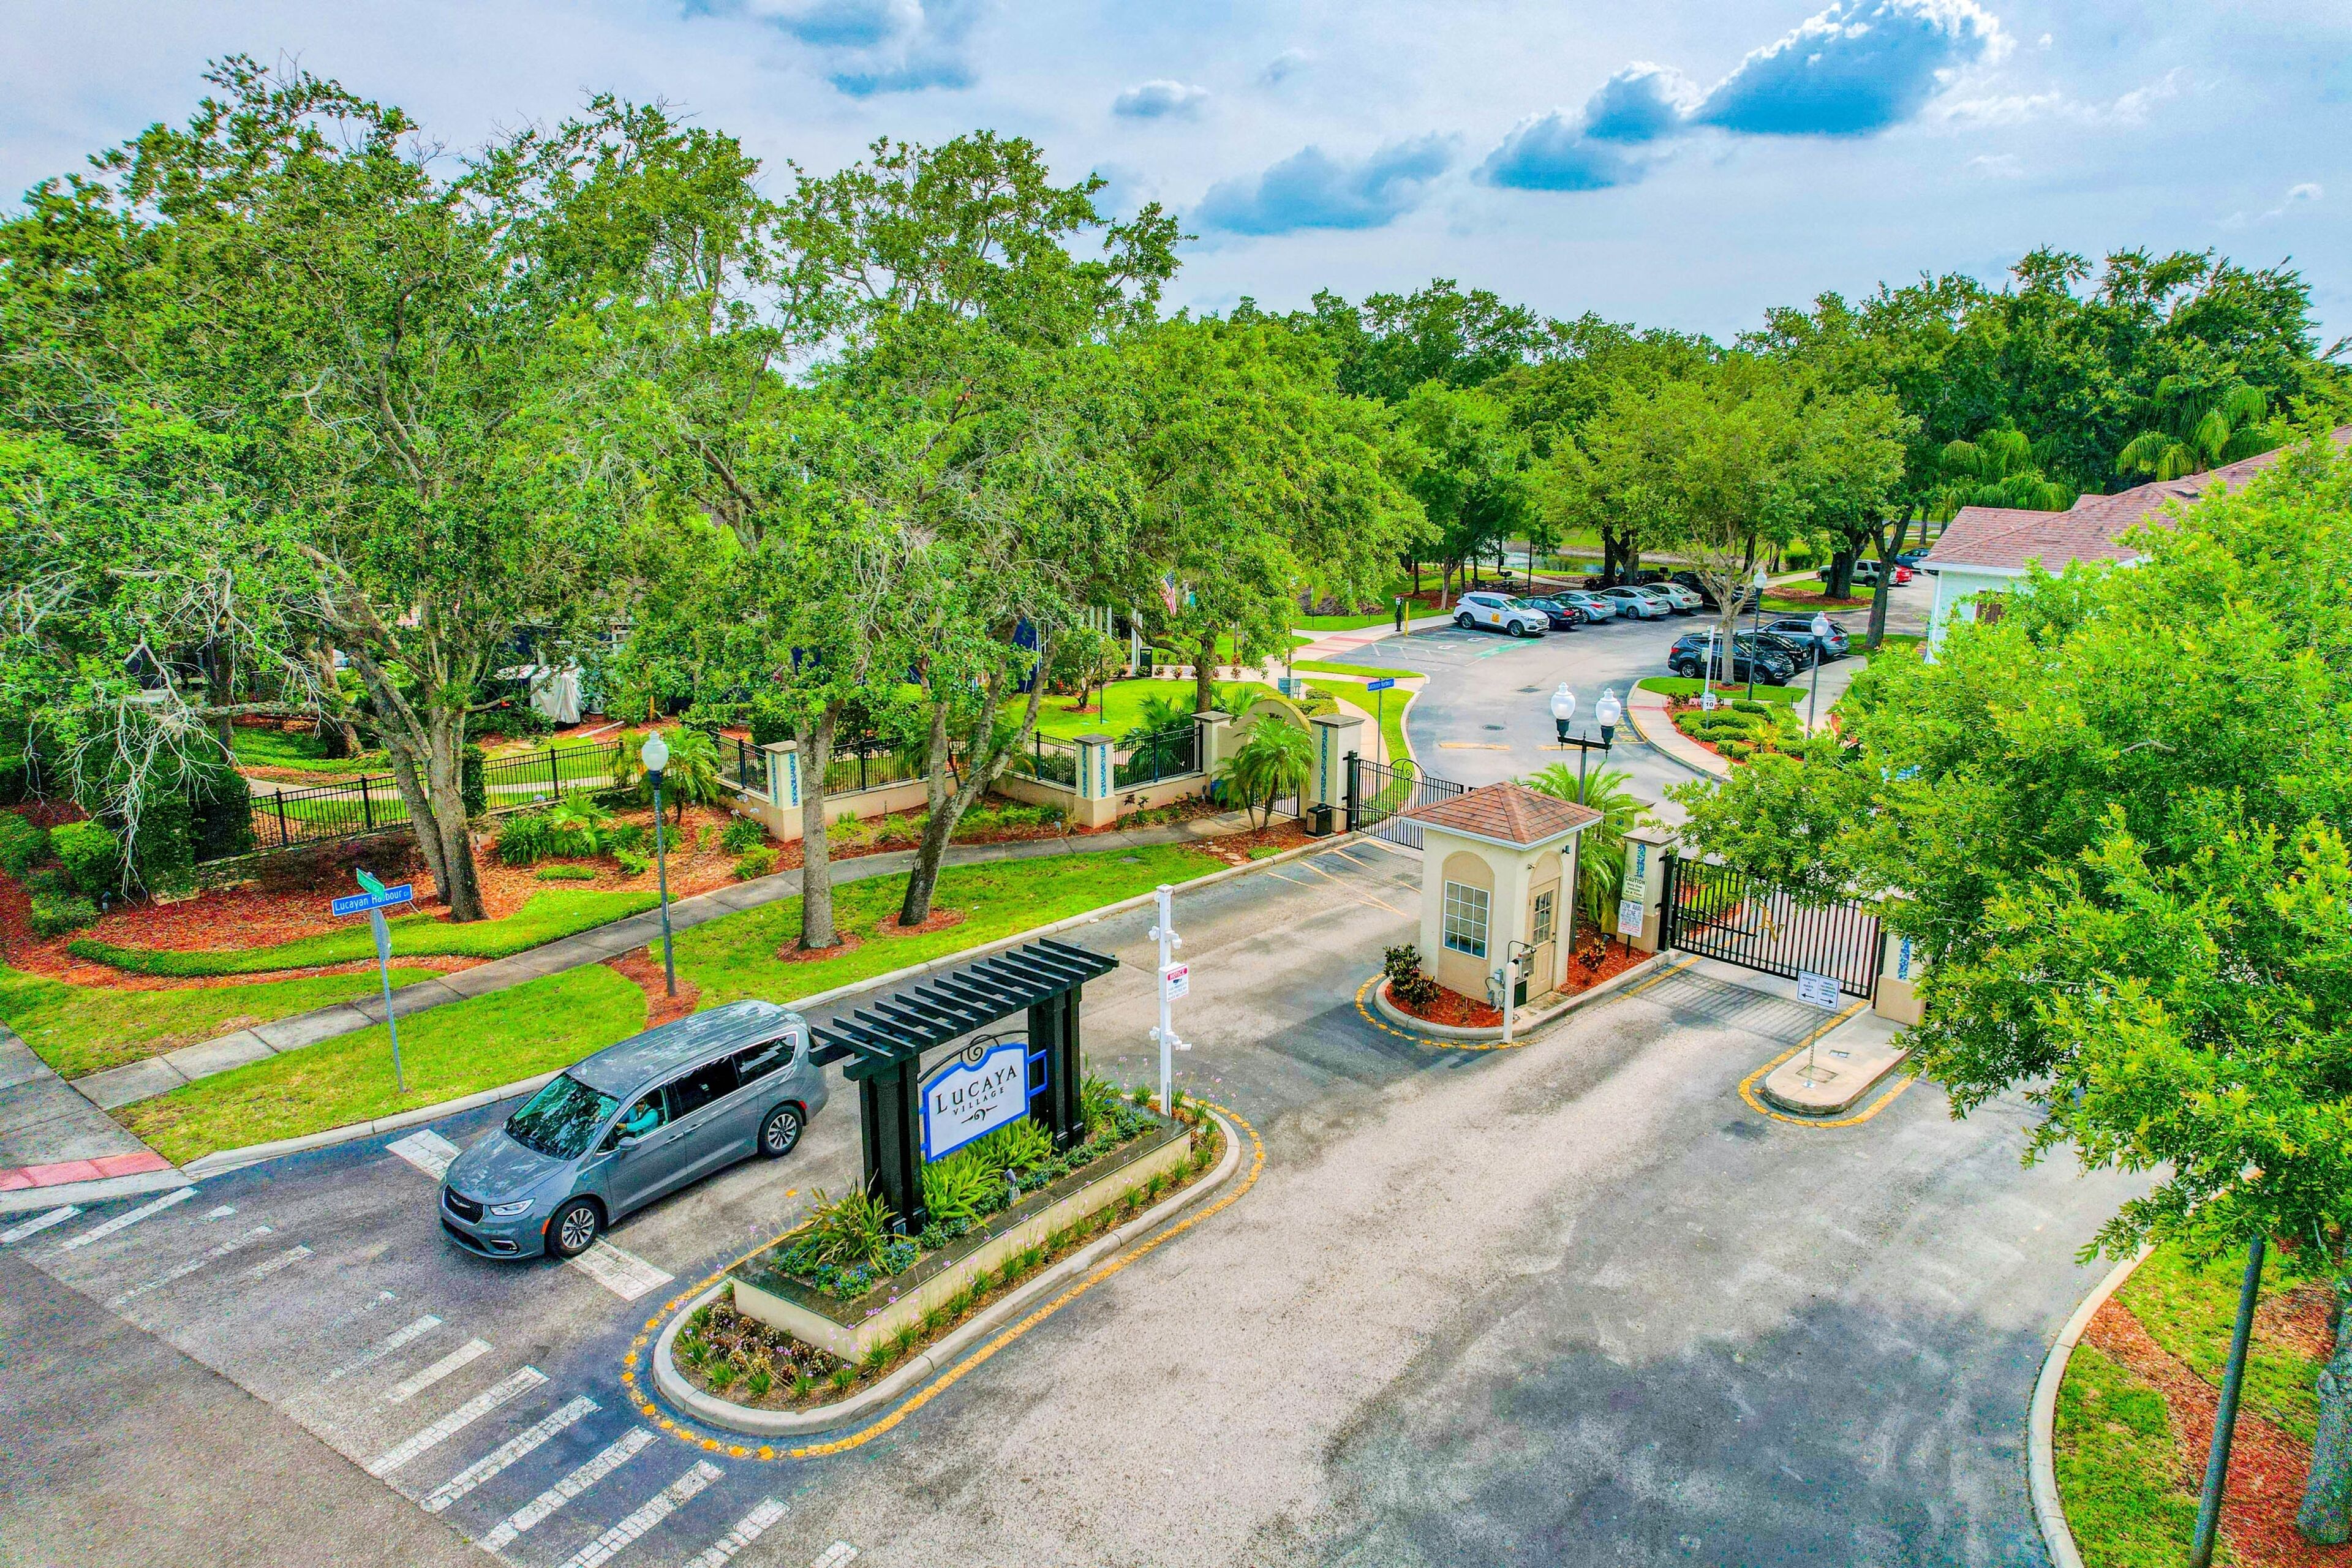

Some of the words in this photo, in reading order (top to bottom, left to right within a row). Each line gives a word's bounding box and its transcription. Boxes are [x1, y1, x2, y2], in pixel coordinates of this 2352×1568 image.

[1625, 876, 1646, 885] CAUTION
[334, 897, 368, 911] Lucayan
[371, 890, 402, 904] Habour
[1169, 969, 1185, 979] NOTICE
[936, 1065, 1017, 1115] LUCAYA
[952, 1086, 1005, 1115] VILLAGE
